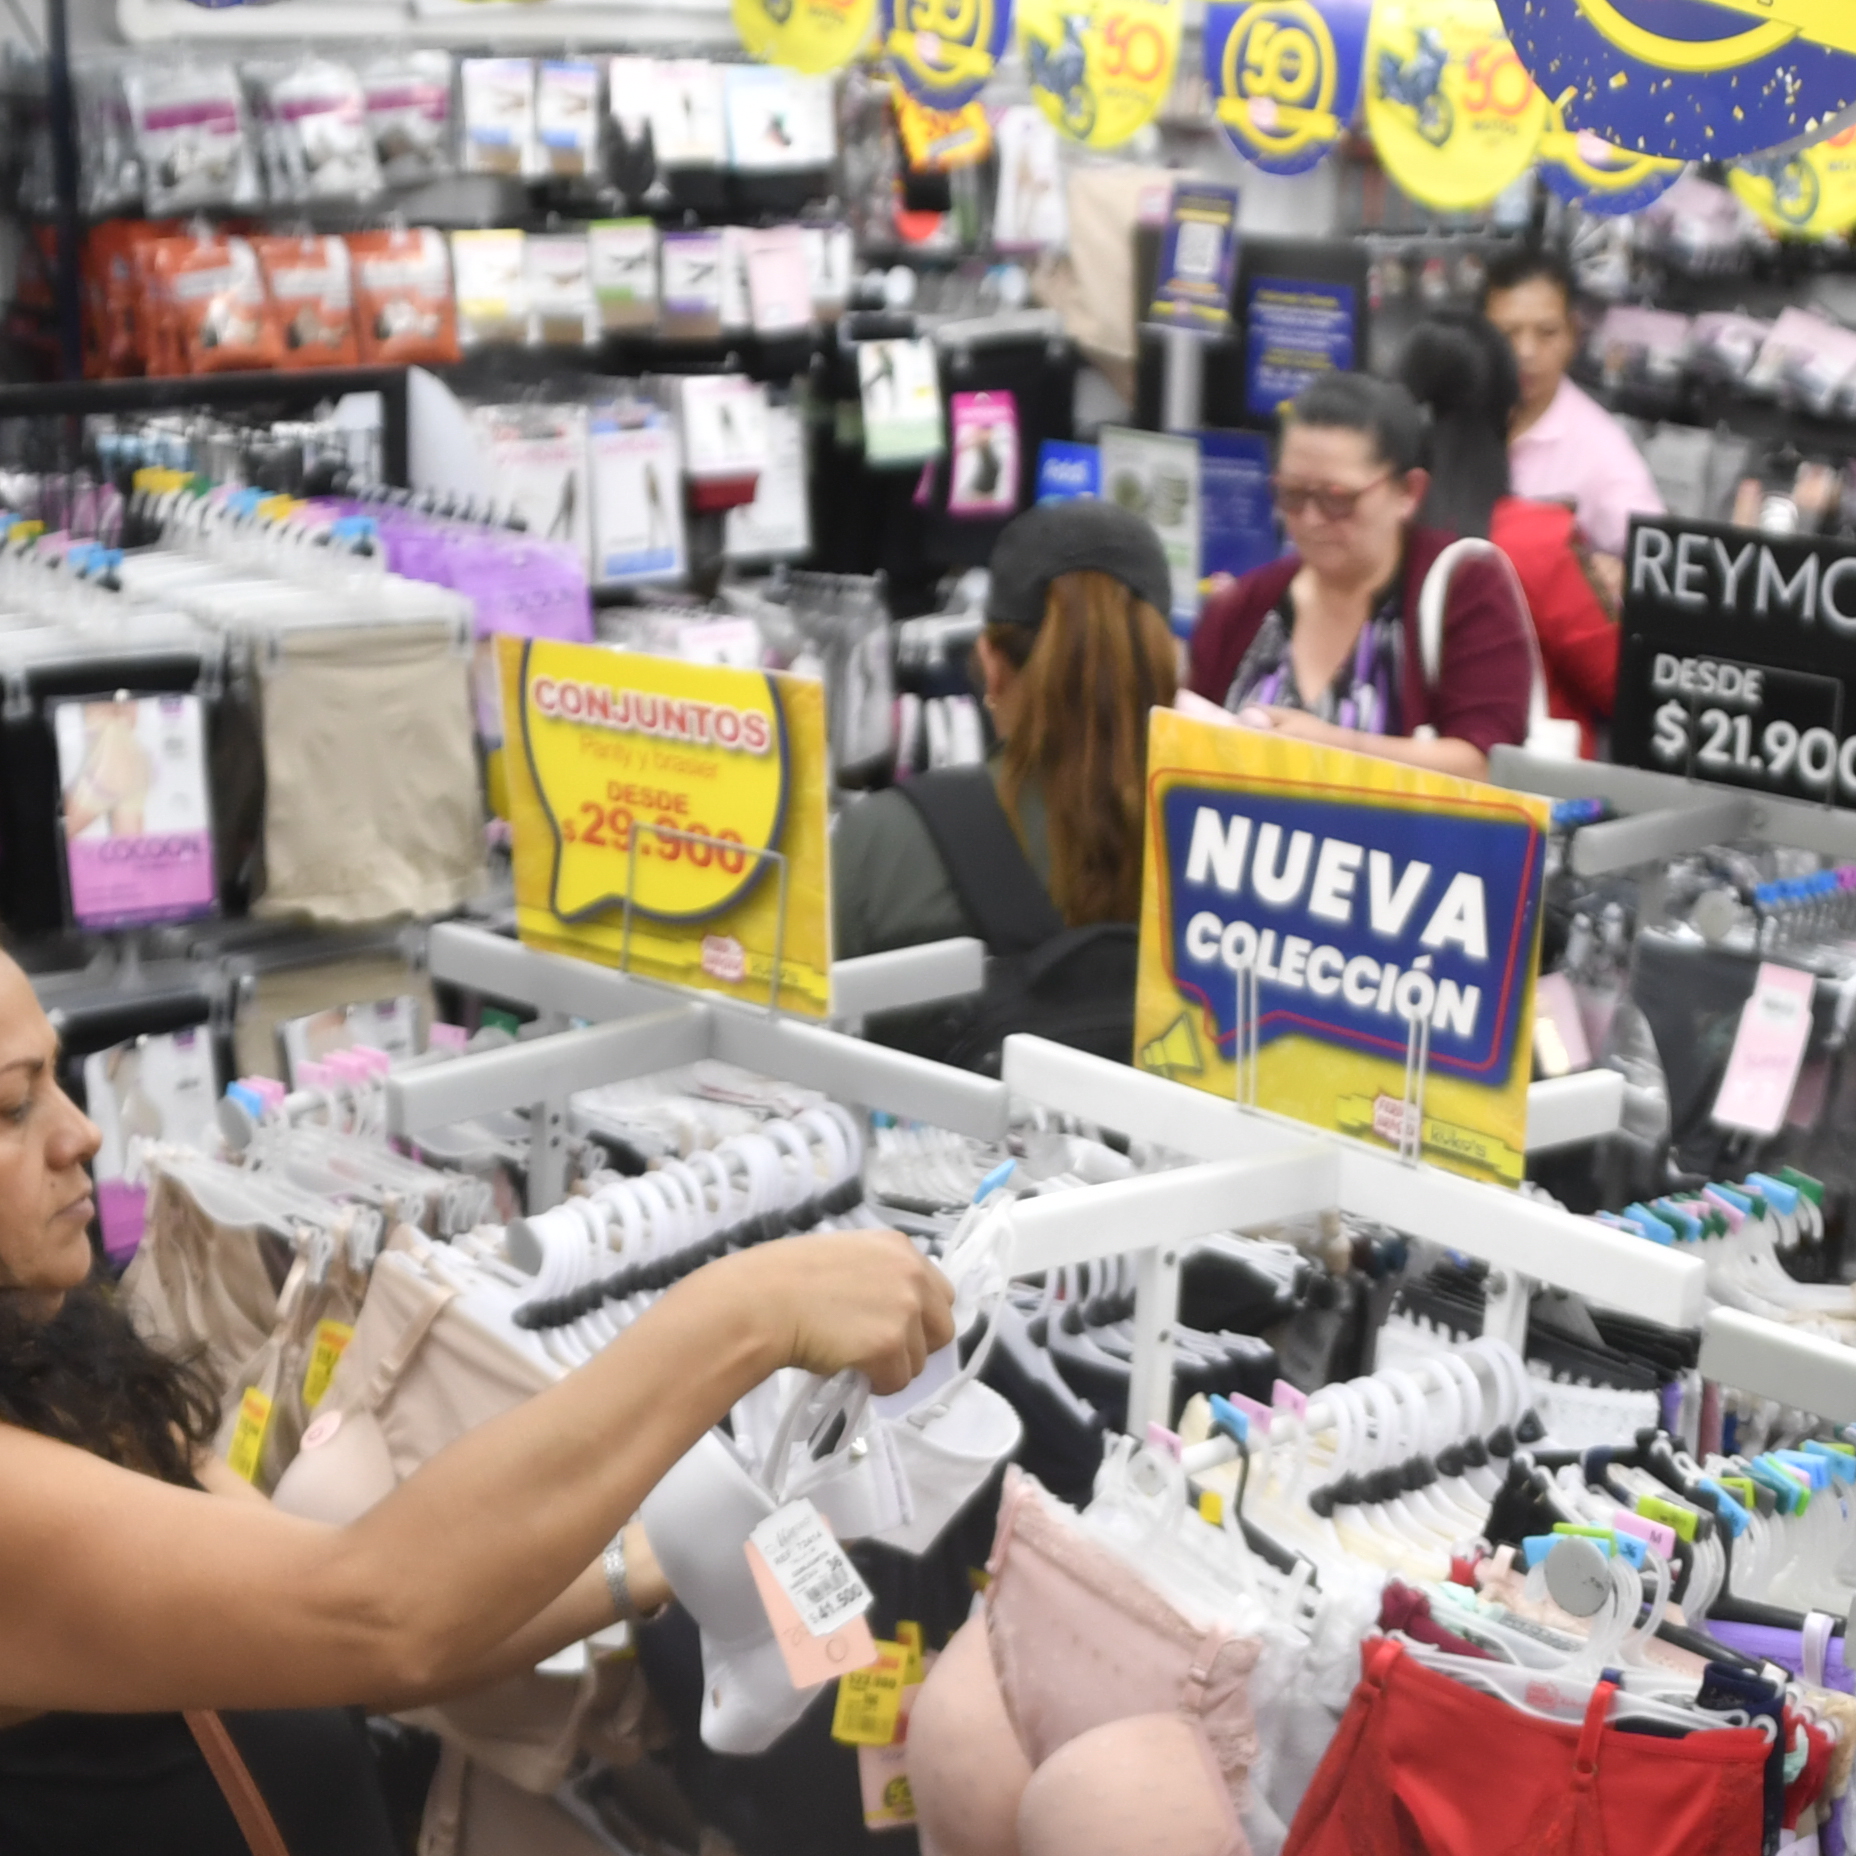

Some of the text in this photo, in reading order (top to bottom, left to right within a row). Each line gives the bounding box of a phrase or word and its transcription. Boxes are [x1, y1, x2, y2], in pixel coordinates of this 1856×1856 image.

[1243, 20, 1317, 100] 50
[1652, 652, 1763, 706] DESDE
[533, 676, 770, 752] CONJUNTOS
[580, 734, 632, 768] Panty
[652, 751, 719, 779] brasier
[606, 780, 690, 815] DESDE
[100, 836, 202, 862] COCOON
[1186, 805, 1489, 962] NUEVA
[1184, 910, 1480, 1039] COLECCIÓN
